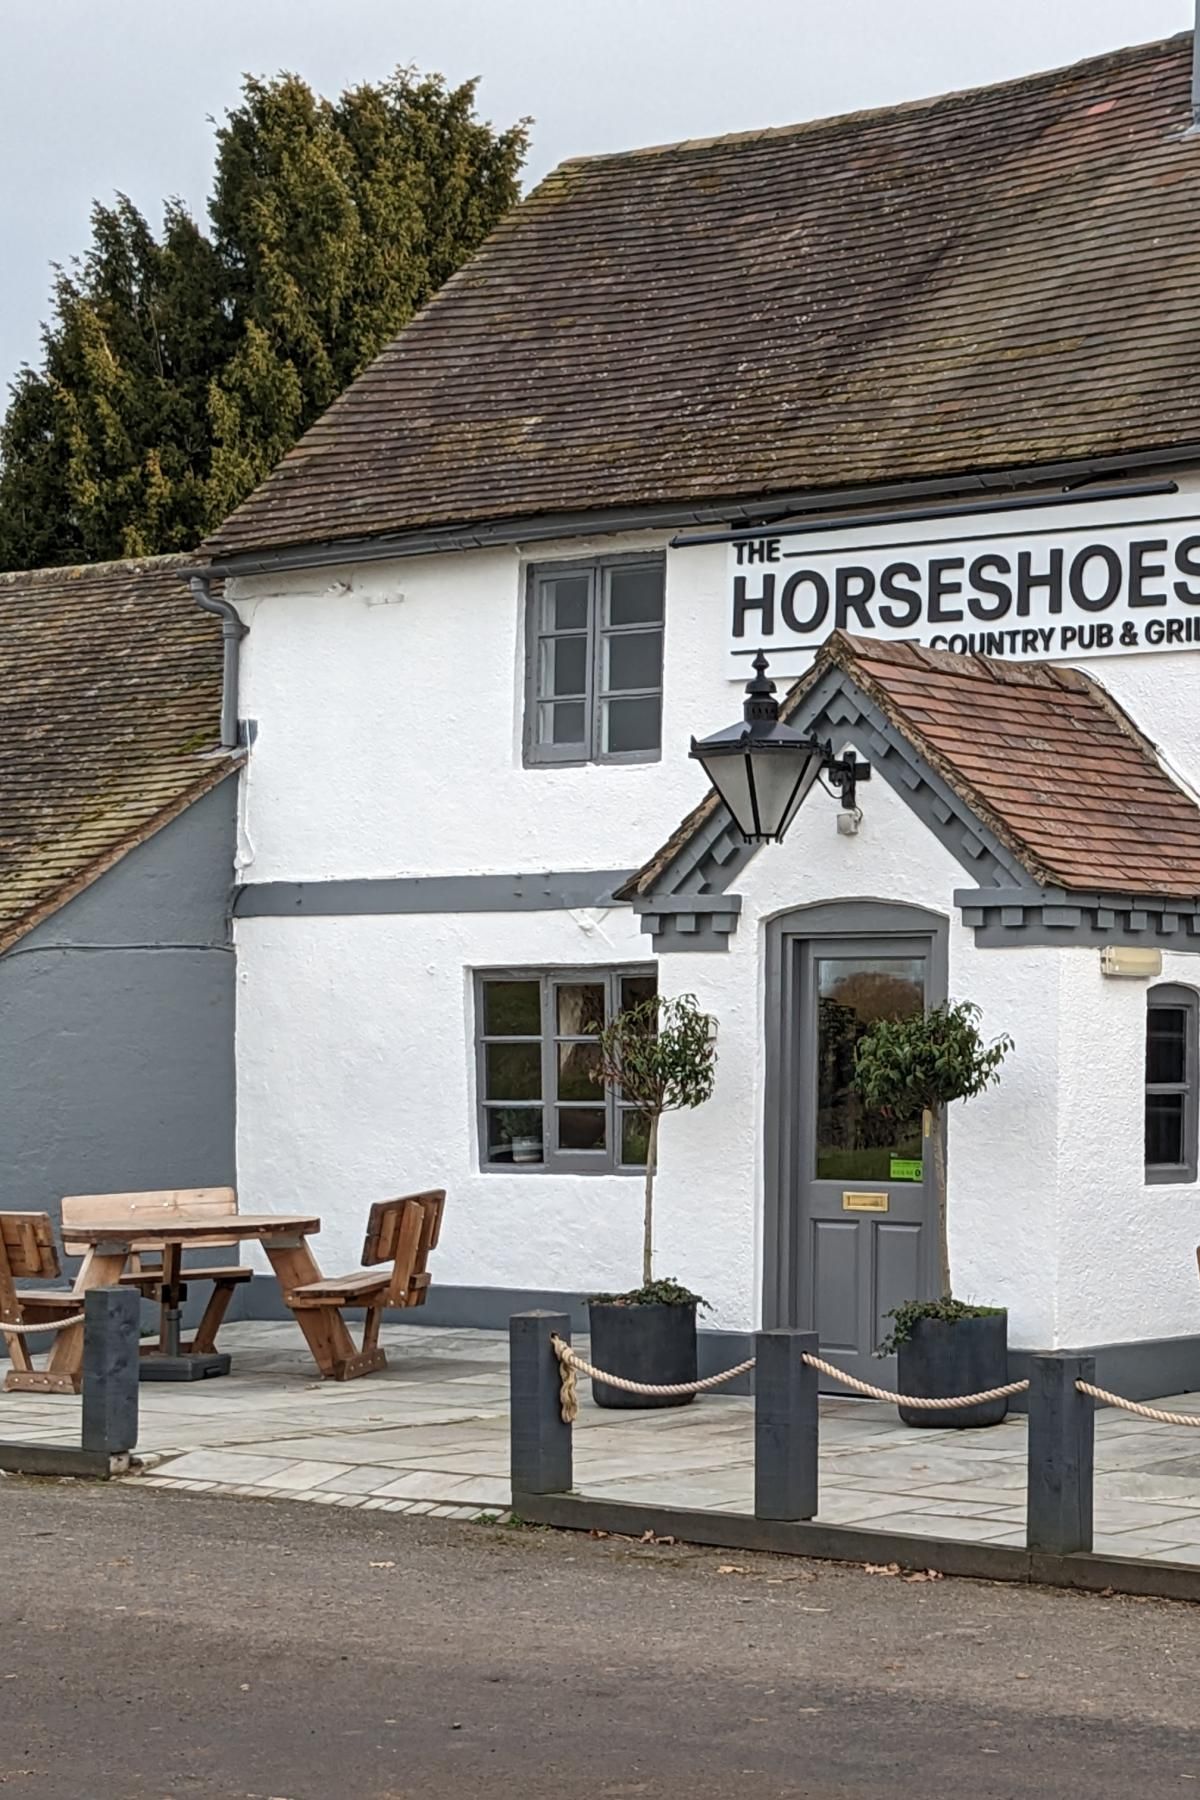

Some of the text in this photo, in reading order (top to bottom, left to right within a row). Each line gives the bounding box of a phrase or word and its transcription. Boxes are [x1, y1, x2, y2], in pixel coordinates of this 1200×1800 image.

[732, 538, 781, 566] THE
[929, 627, 1056, 656] COUNTRY
[1060, 623, 1114, 651] PUB
[1119, 621, 1139, 647] &
